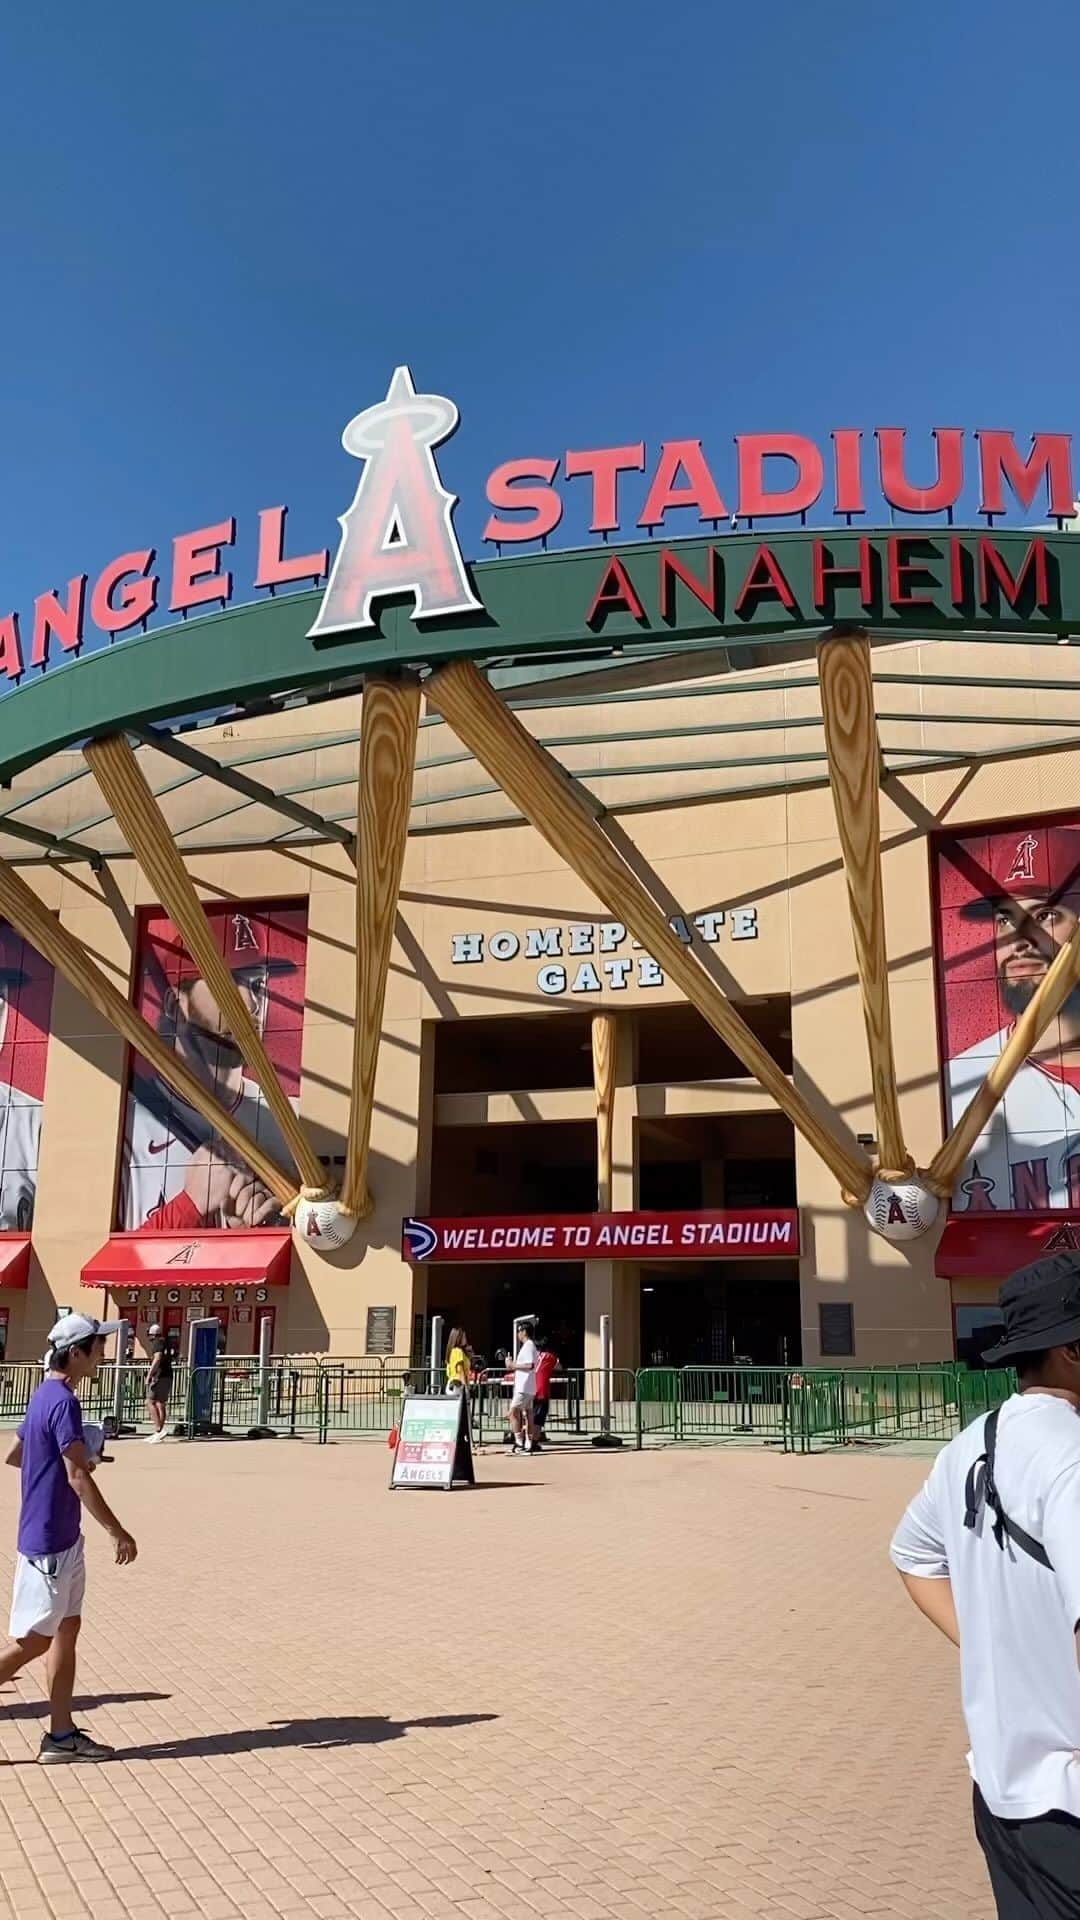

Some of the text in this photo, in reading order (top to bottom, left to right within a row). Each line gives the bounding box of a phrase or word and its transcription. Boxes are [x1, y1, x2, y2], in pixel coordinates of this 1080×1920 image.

[305, 365, 485, 639] A
[482, 428, 1078, 543] STADIUM
[585, 536, 1051, 631] ANAHEIM
[452, 908, 758, 964] HOMEPATE
[536, 956, 664, 995] GATE
[443, 1222, 792, 1249] WELCOME TO ANGEL STADIUM
[128, 1287, 269, 1304] TICKETS
